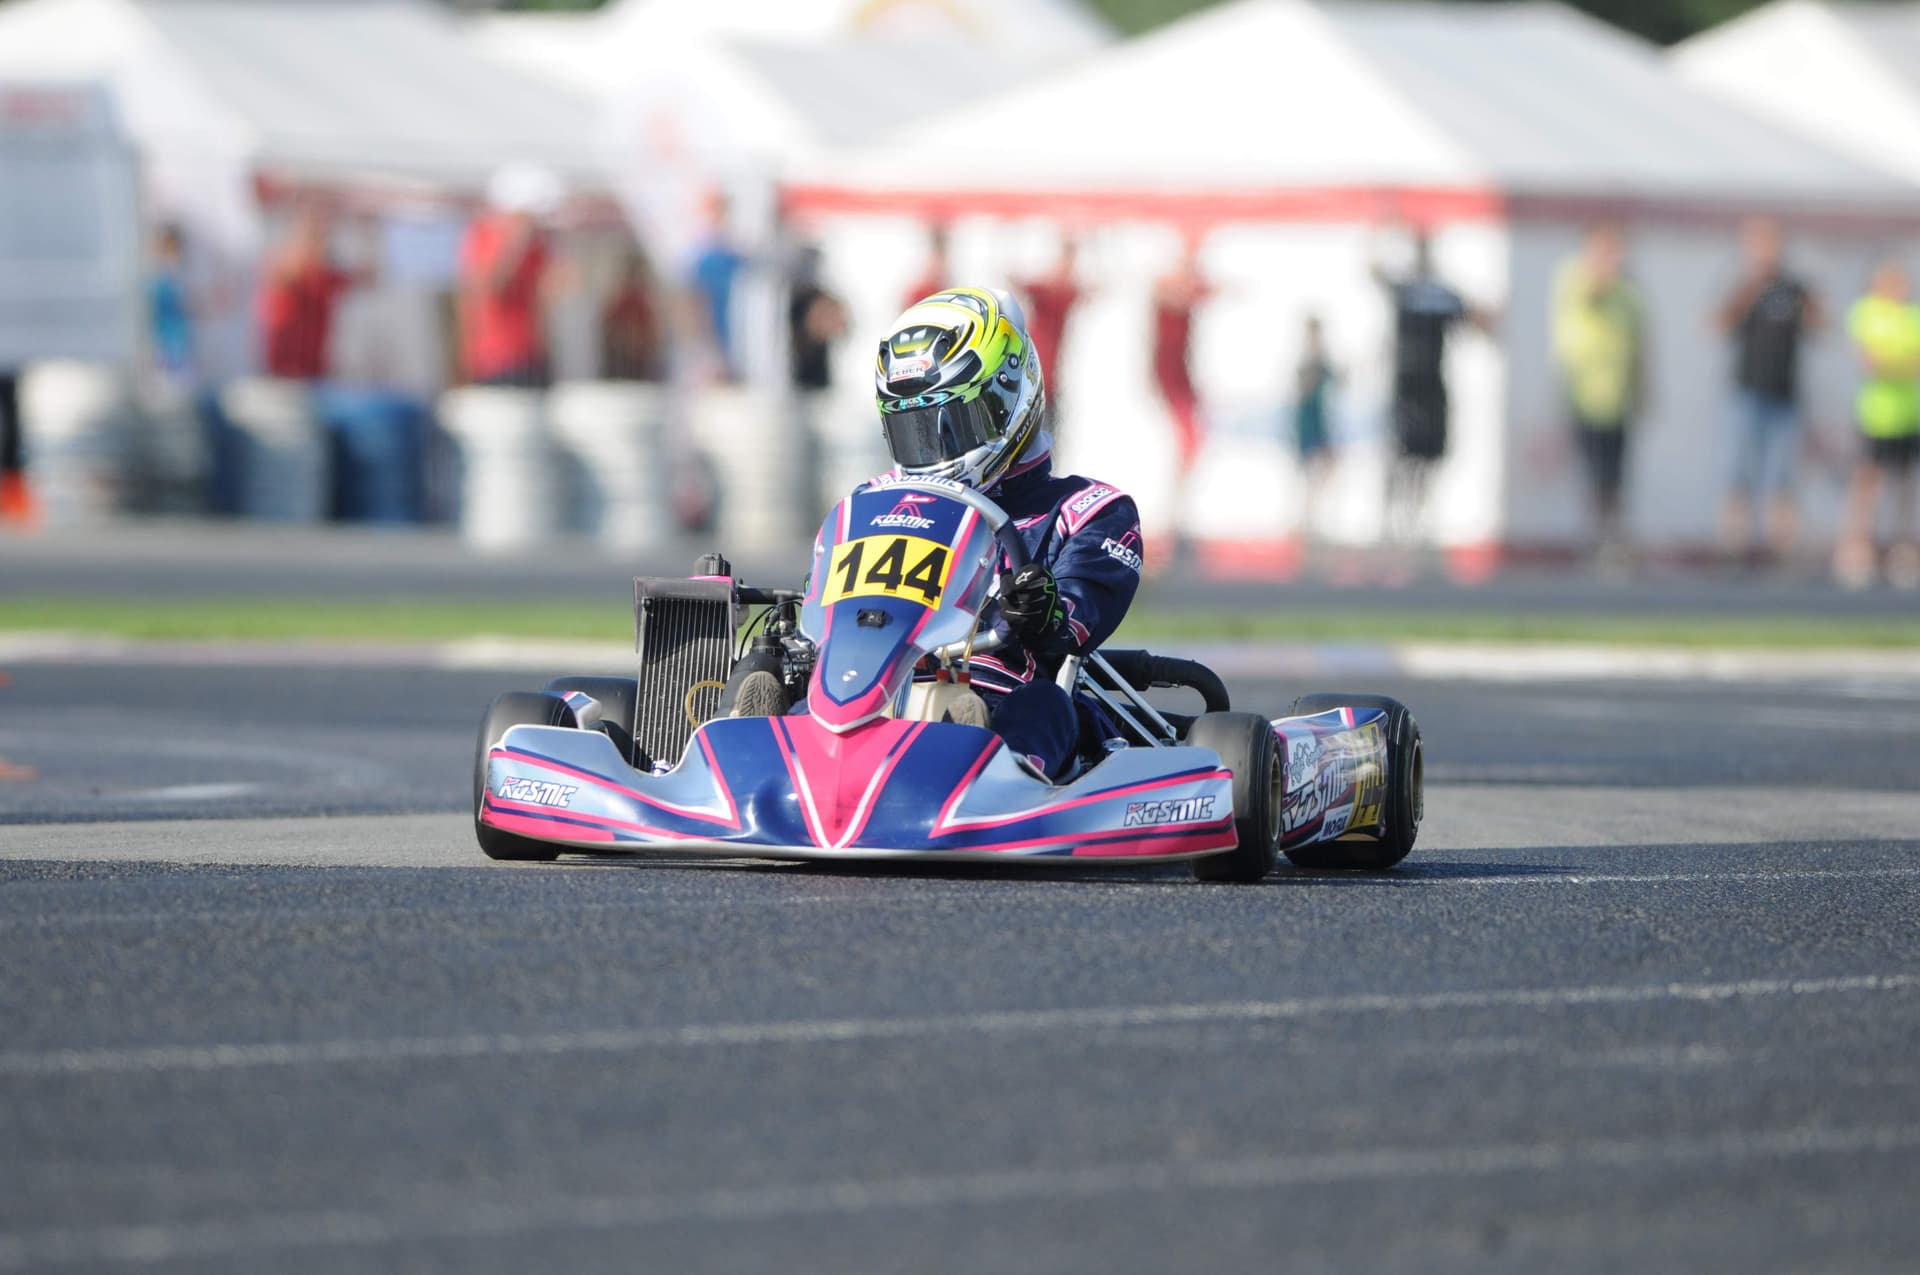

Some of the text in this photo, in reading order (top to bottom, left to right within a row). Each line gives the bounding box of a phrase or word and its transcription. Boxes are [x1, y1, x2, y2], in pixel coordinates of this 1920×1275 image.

[870, 515, 935, 528] KOSMIC
[836, 538, 948, 600] 144
[499, 777, 577, 806] KOSMIC
[1124, 796, 1215, 827] KOSMIC
